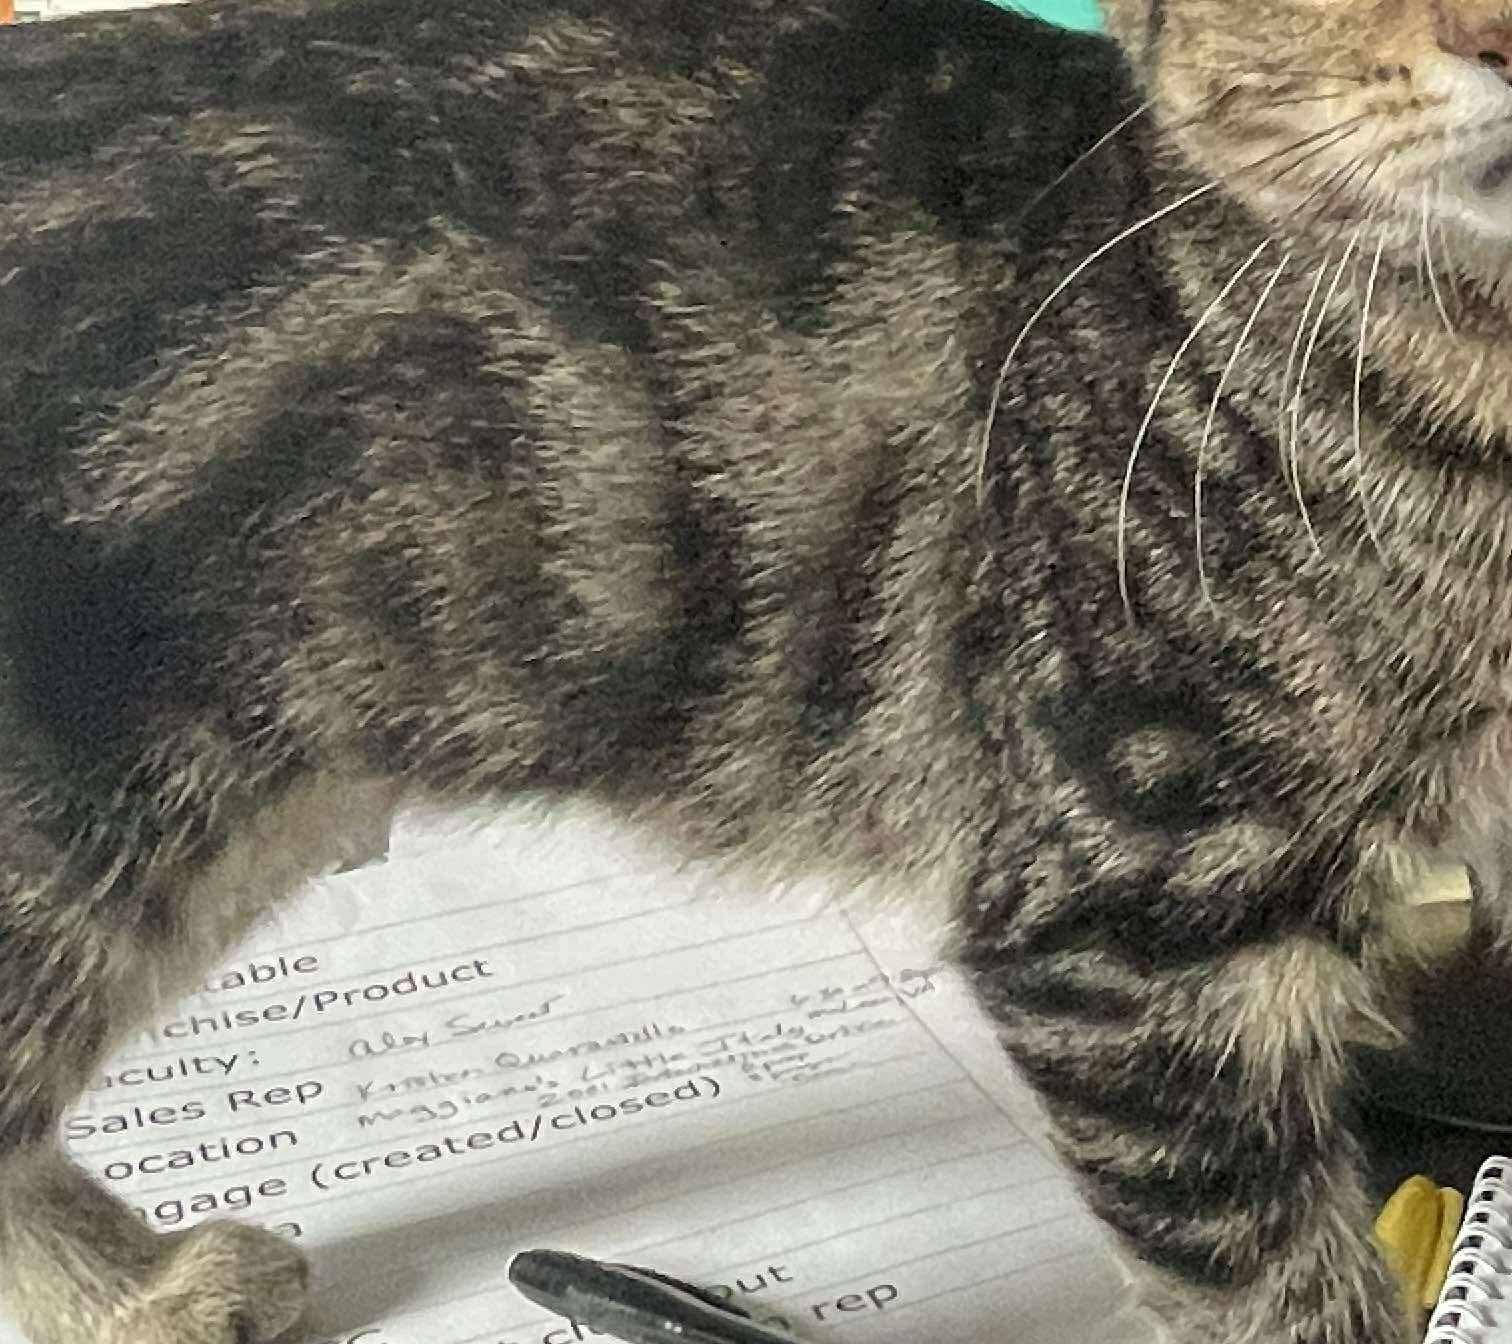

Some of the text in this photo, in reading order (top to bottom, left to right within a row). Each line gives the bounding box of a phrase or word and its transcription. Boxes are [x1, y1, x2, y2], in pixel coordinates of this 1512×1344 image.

[105, 1050, 260, 1090] culty:
[64, 1079, 323, 1141] Sales Rep
[310, 1076, 721, 1191] (created/closed)
[103, 1128, 299, 1182] ocation
[810, 1283, 899, 1322] rep
